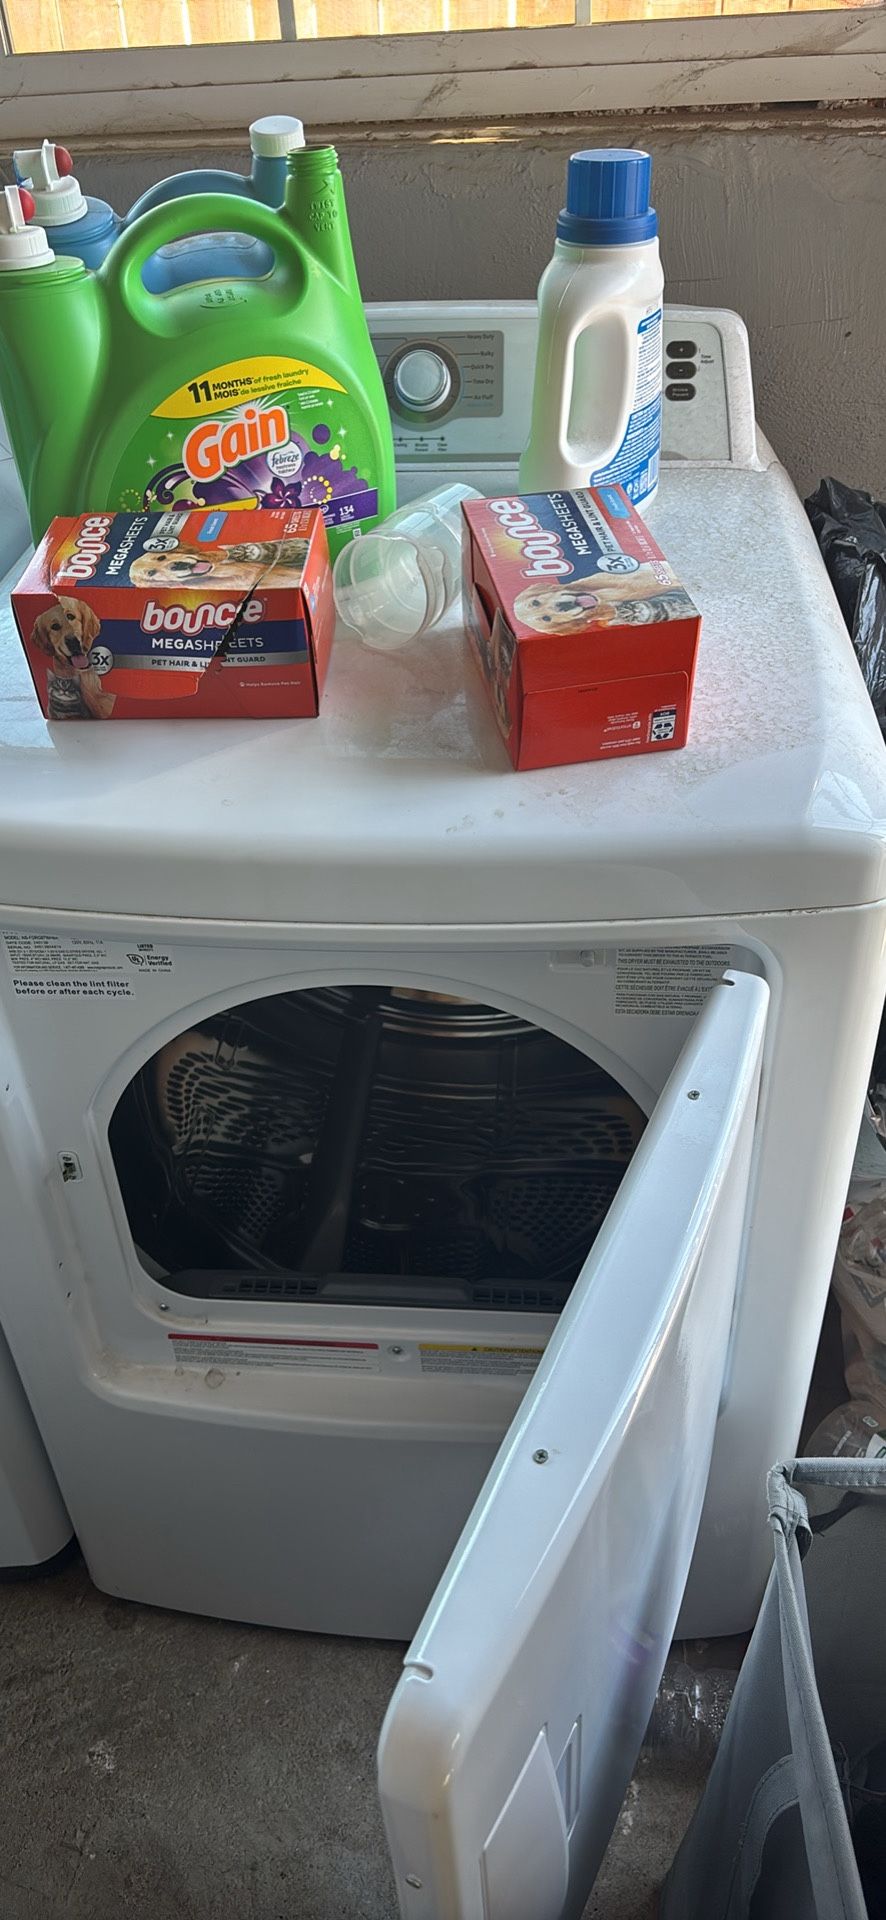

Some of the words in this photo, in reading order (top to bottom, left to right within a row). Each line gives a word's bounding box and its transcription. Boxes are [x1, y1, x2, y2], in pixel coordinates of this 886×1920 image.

[253, 376, 263, 384] of
[263, 373, 282, 383] fresh
[283, 368, 309, 380] laundry
[187, 380, 213, 404] 11
[240, 387, 249, 395] de
[250, 383, 276, 394] lessive
[185, 407, 288, 481] Gain
[271, 452, 300, 468] febreze
[575, 490, 592, 509] GUARD
[339, 505, 355, 516] 134
[585, 508, 598, 522] LINT
[548, 492, 592, 557] MEGASHEETS
[489, 499, 573, 578] bounce
[595, 526, 609, 541] HAIR
[58, 516, 112, 578] bounce
[105, 516, 148, 576] MEGASHEETS
[603, 540, 616, 553] PET
[654, 573, 673, 586] 65
[142, 600, 263, 635] bounce
[151, 659, 168, 667] PET
[168, 660, 191, 668] HAIR
[191, 660, 198, 668] &
[46, 980, 72, 988] clean
[59, 988, 82, 996] after
[106, 989, 135, 997] cycle.
